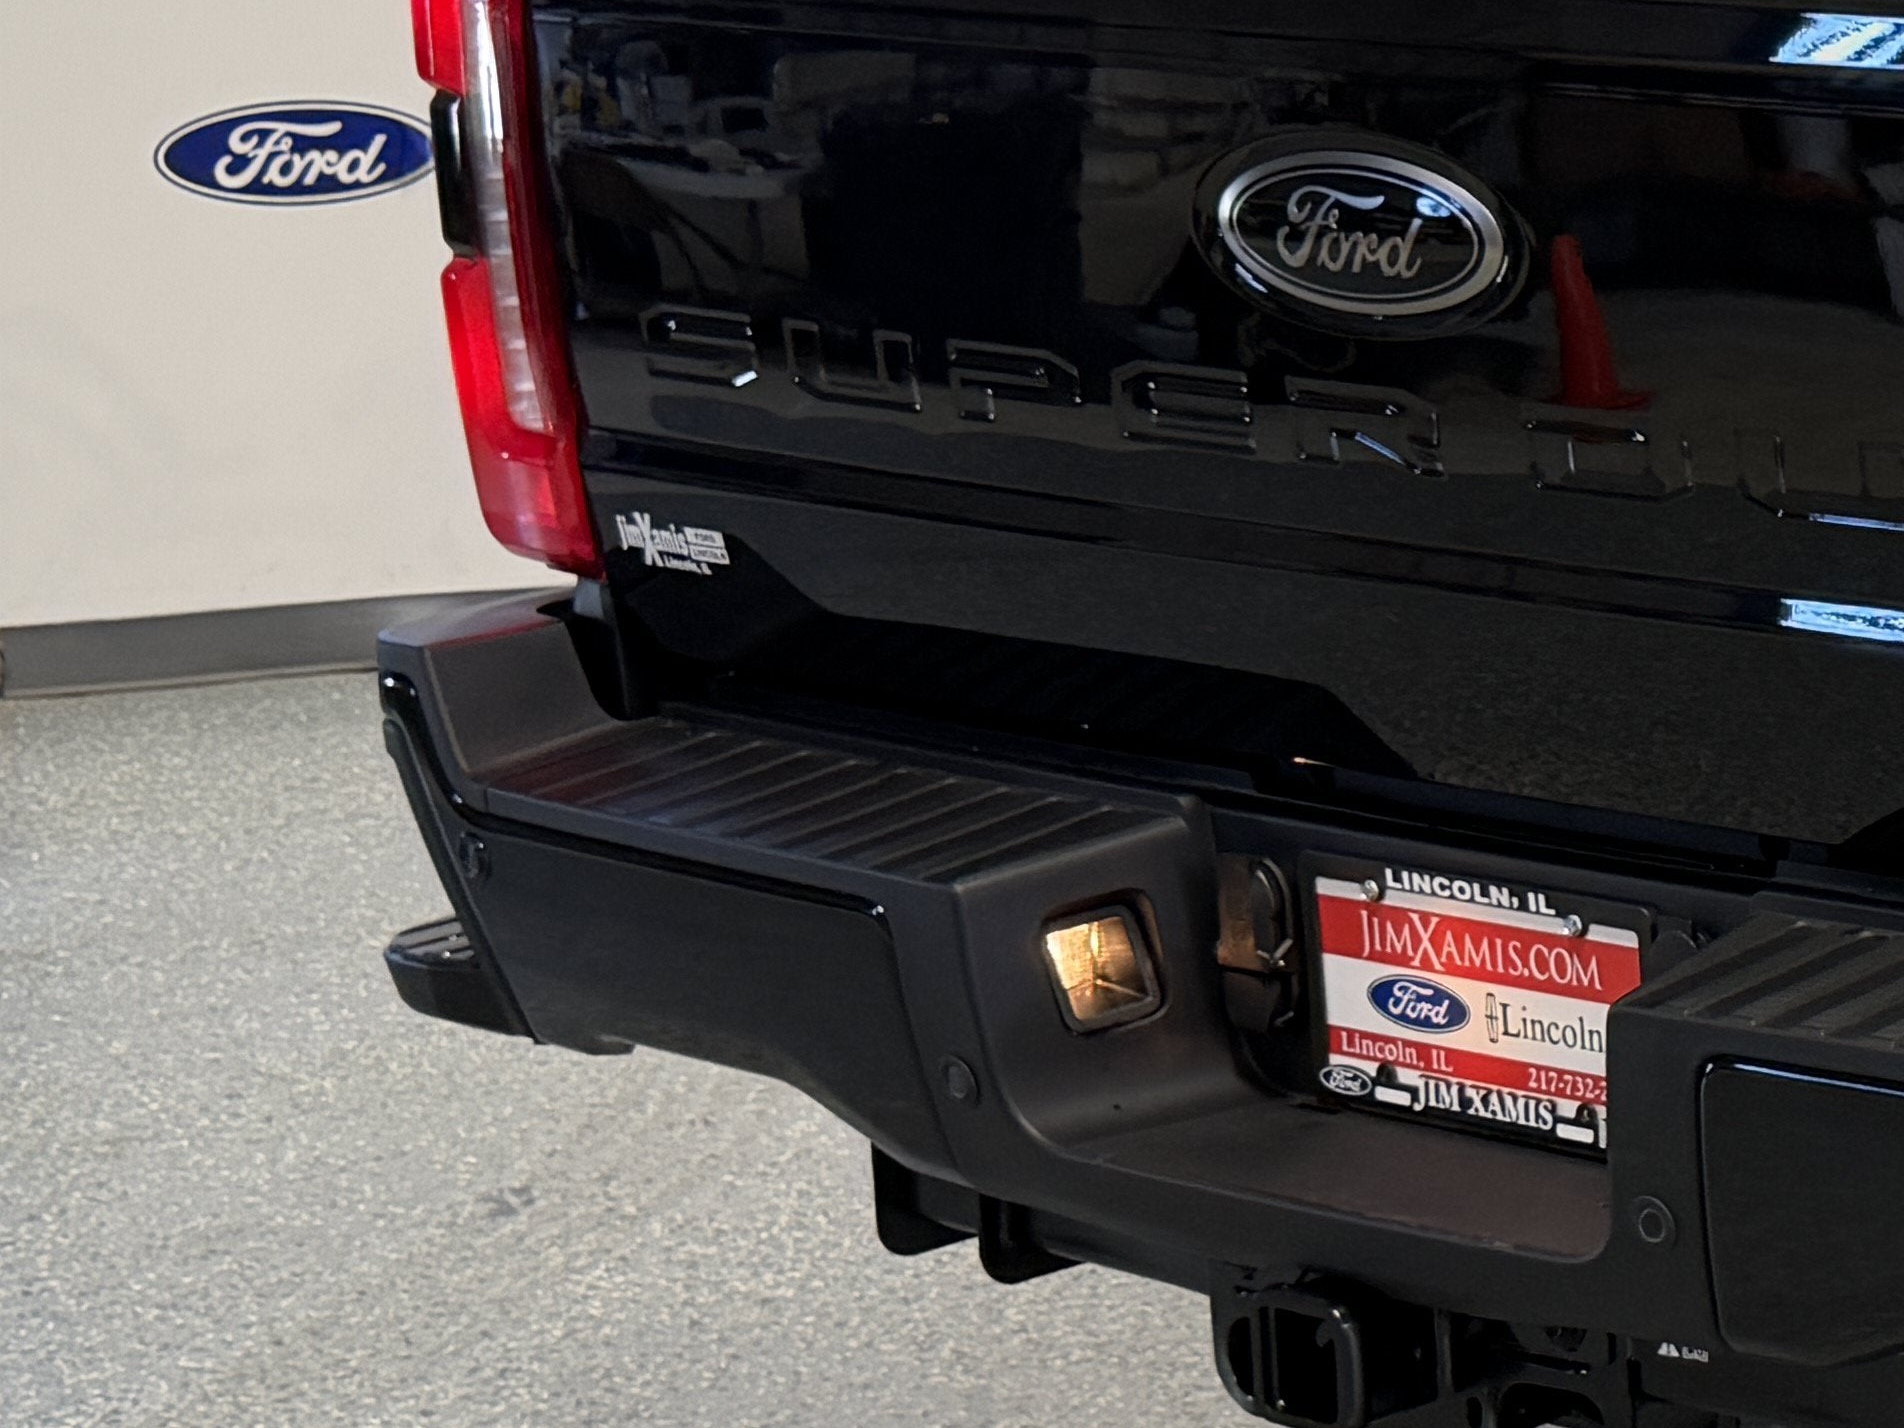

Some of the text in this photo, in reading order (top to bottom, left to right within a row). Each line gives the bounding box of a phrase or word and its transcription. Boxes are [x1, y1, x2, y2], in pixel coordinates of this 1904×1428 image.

[214, 119, 387, 189] Ford
[1276, 184, 1424, 279] Ford
[638, 306, 1449, 479] SUPER
[1384, 867, 1556, 915] LINCOLN, IL
[1387, 980, 1450, 1026] Ford
[1500, 1002, 1604, 1054] Lincoln
[1329, 1066, 1363, 1092] Ford
[1431, 1048, 1454, 1072] IL
[1412, 1076, 1554, 1131] JIM XAMIS
